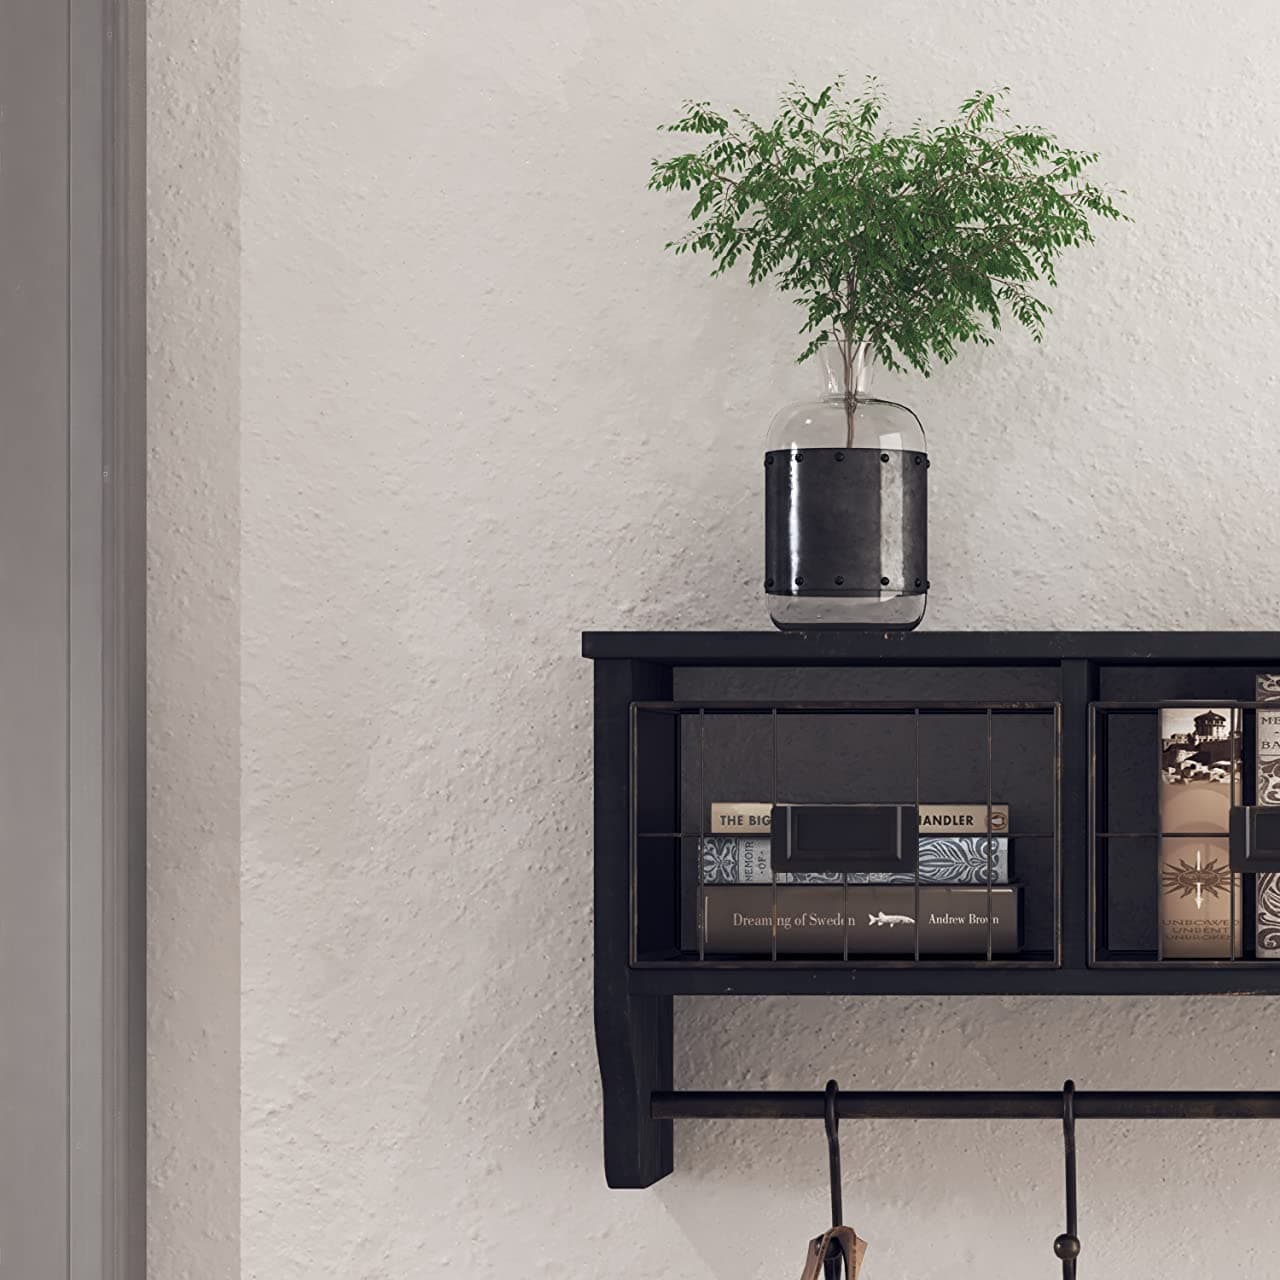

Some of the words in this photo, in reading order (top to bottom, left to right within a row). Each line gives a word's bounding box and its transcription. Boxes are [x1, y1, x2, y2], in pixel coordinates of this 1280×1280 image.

[720, 815, 744, 826] THE
[748, 815, 771, 826] BIG
[733, 913, 792, 929] Dreamng
[794, 912, 808, 926] of
[928, 913, 966, 925] Andrew
